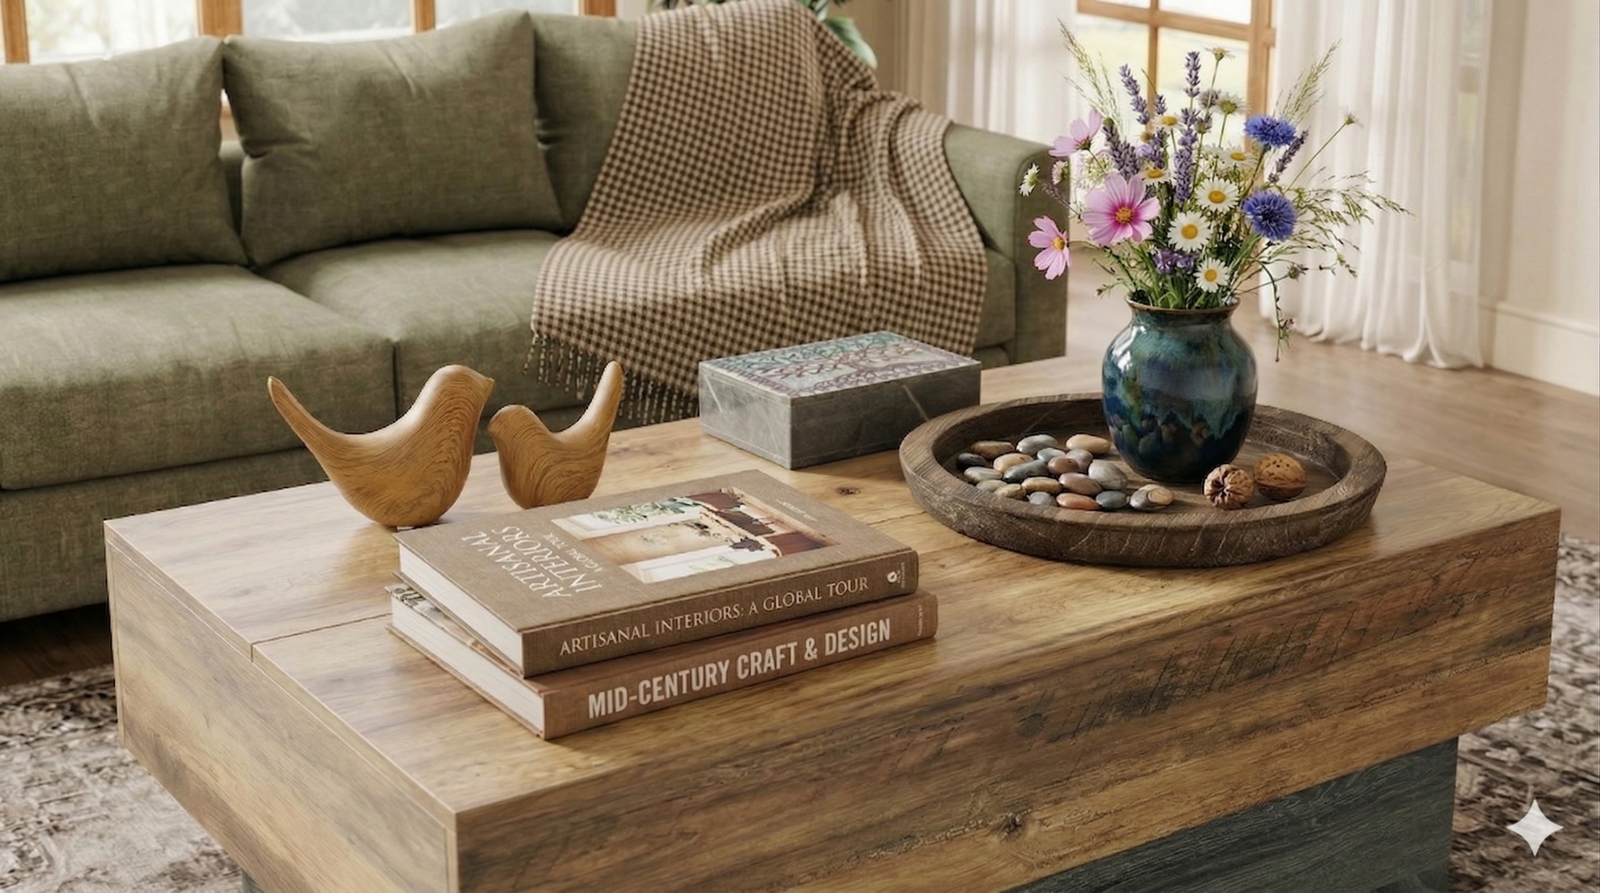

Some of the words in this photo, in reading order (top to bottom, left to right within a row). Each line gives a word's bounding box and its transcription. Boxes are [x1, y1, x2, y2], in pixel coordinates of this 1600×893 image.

[461, 531, 573, 598] ARTISANAL
[491, 526, 603, 593] INTERIORS
[560, 624, 650, 656] ARTISANAL
[655, 603, 746, 635] INTERIORS:
[748, 602, 758, 615] A
[763, 586, 822, 612] GLOBAL
[826, 576, 870, 598] TOUR
[588, 659, 730, 720] MID-CENTURY
[737, 641, 798, 680] CRAFT
[804, 637, 818, 662] &
[825, 618, 891, 656] DESIGN
